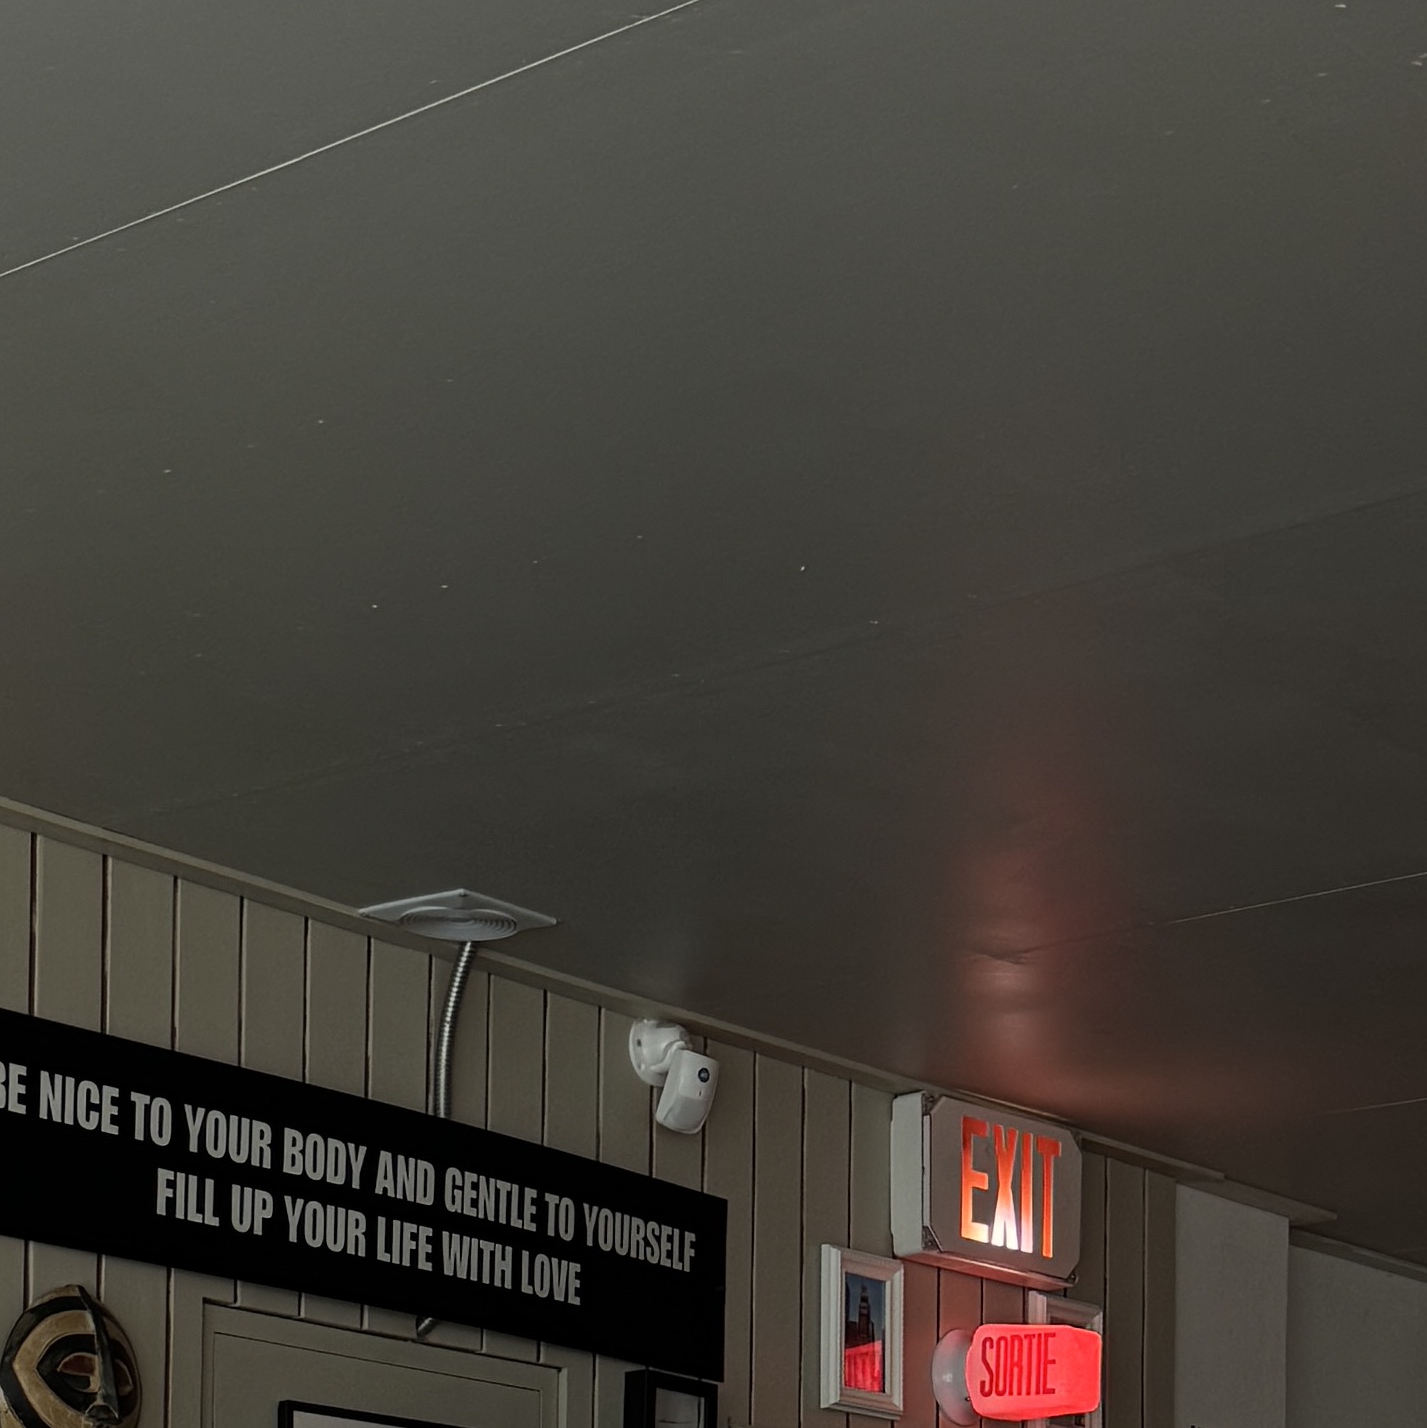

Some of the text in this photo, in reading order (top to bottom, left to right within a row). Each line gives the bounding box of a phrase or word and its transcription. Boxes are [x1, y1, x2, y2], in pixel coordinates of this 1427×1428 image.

[39, 1072, 120, 1136] NICE
[131, 1090, 172, 1147] TO
[184, 1103, 271, 1170] YOUR
[283, 1127, 366, 1190] BODY
[376, 1150, 435, 1206] AND
[444, 1171, 537, 1233] GENTLE
[543, 1194, 575, 1242] TO
[583, 1203, 696, 1273] YOURSELF
[156, 1168, 582, 1306] FILL UP YOUR LIFE WITH LOVE
[960, 1115, 1062, 1259] EXIT
[979, 1332, 1057, 1398] SORTIE
